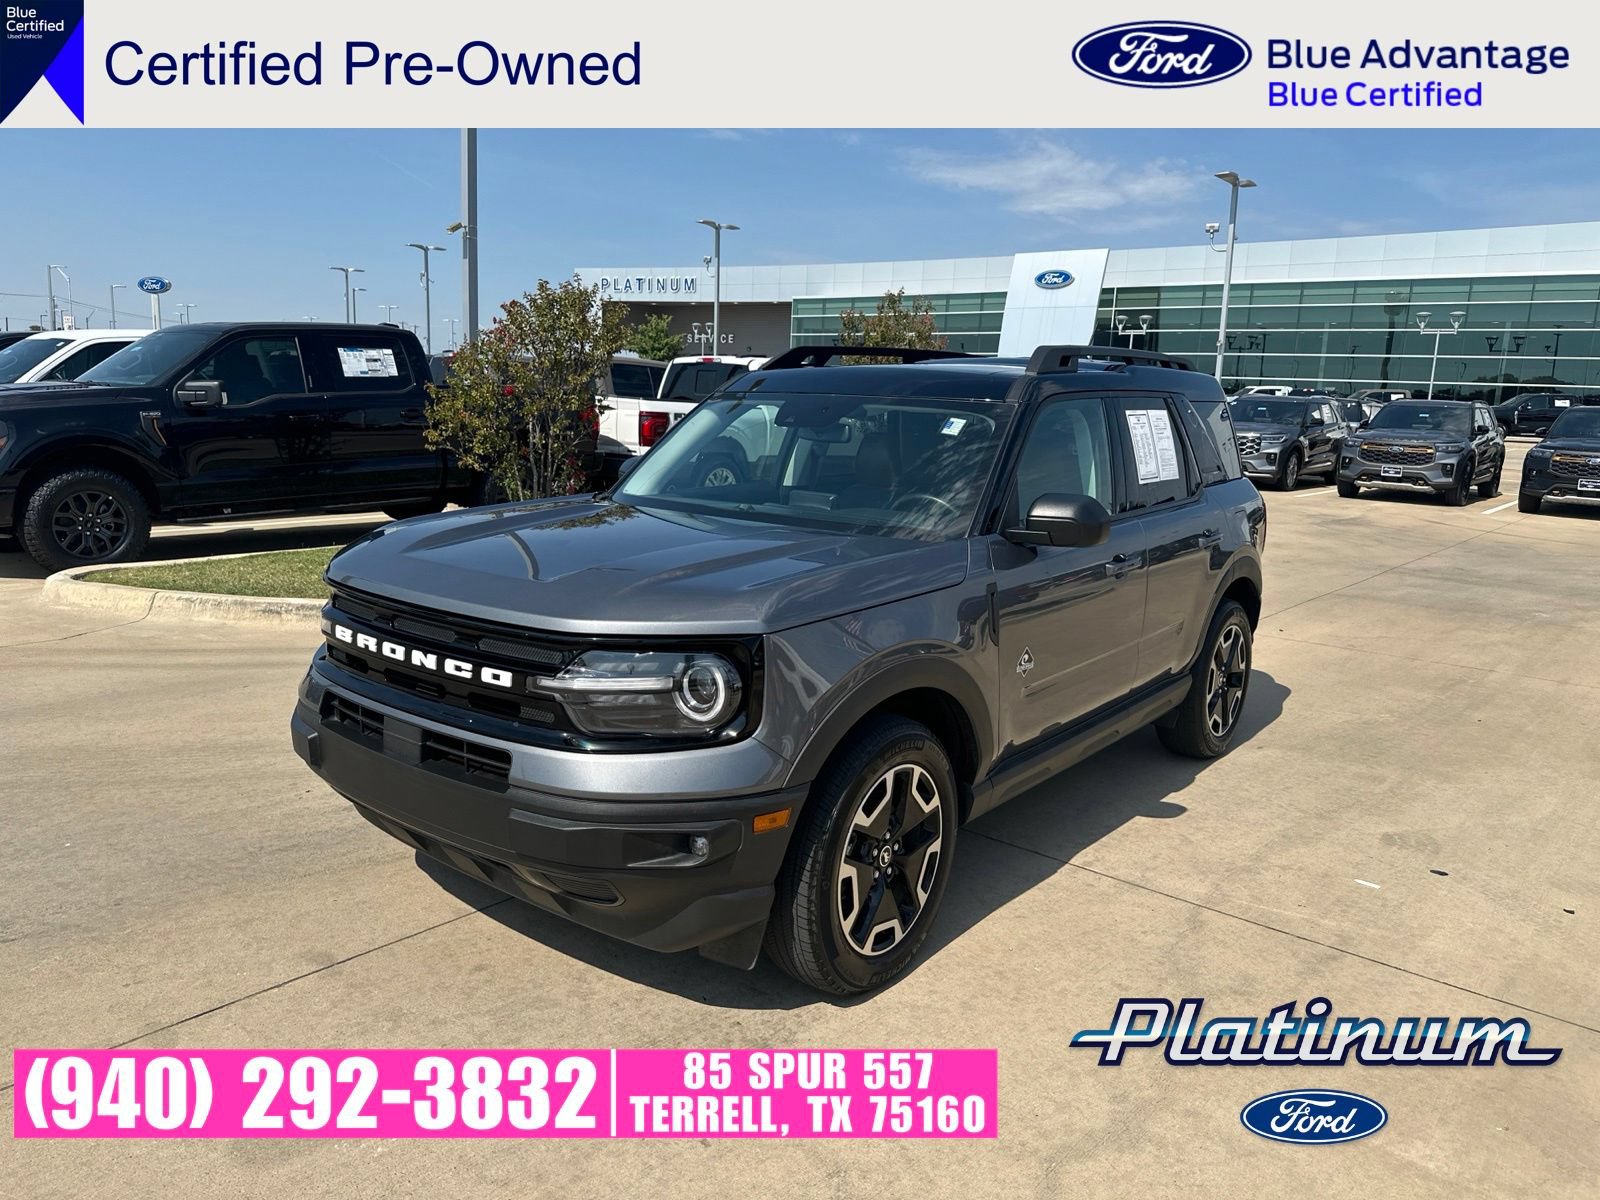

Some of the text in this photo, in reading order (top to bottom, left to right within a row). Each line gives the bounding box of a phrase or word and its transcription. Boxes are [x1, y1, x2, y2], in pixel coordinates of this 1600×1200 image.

[600, 277, 697, 293] PLATINUM
[687, 334, 734, 344] SERVCE
[335, 624, 512, 688] BRONCO
